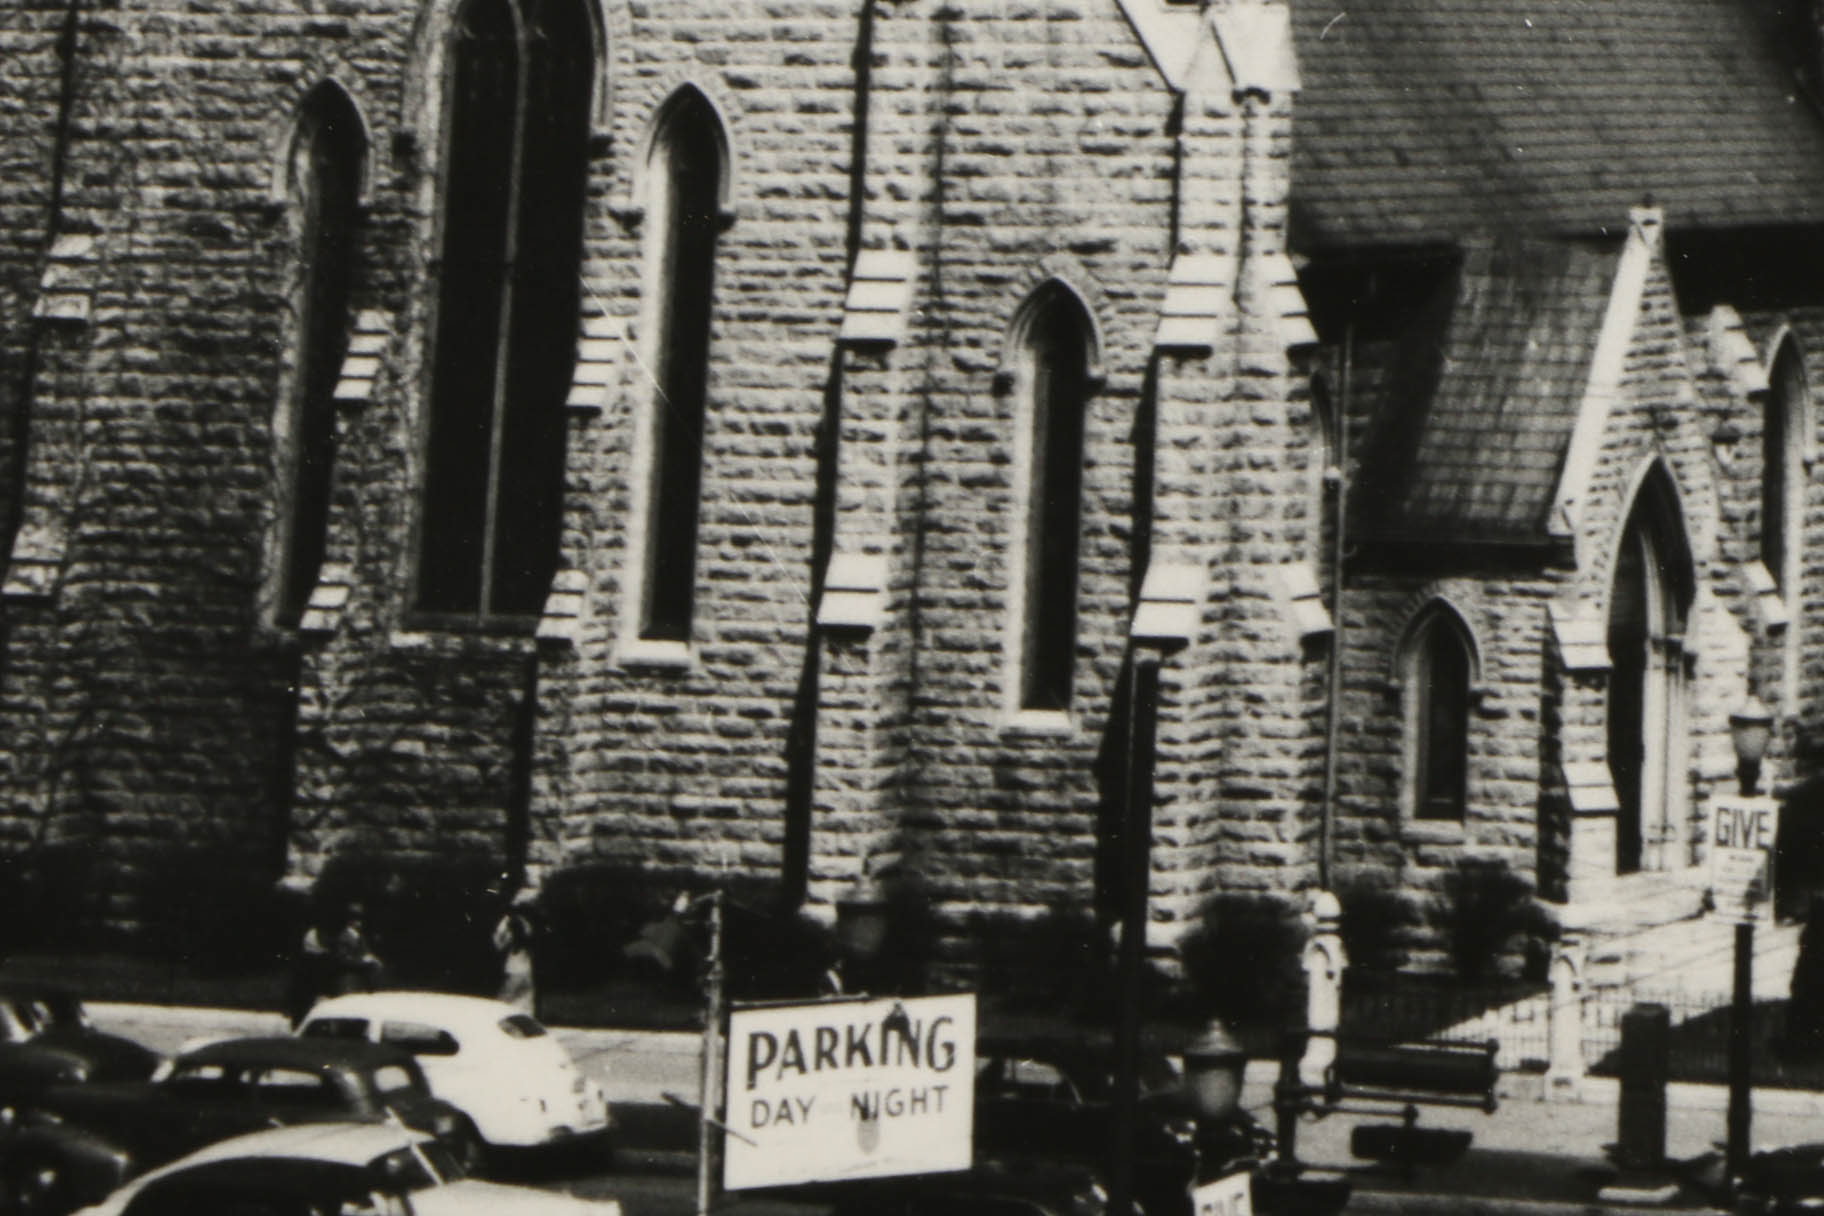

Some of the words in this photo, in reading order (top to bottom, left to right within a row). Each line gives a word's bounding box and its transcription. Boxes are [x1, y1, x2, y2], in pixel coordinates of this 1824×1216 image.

[1716, 806, 1770, 849] GIVE
[746, 1016, 956, 1091] PARKING
[751, 1095, 815, 1128] DAY
[851, 1085, 950, 1121] NIGHT
